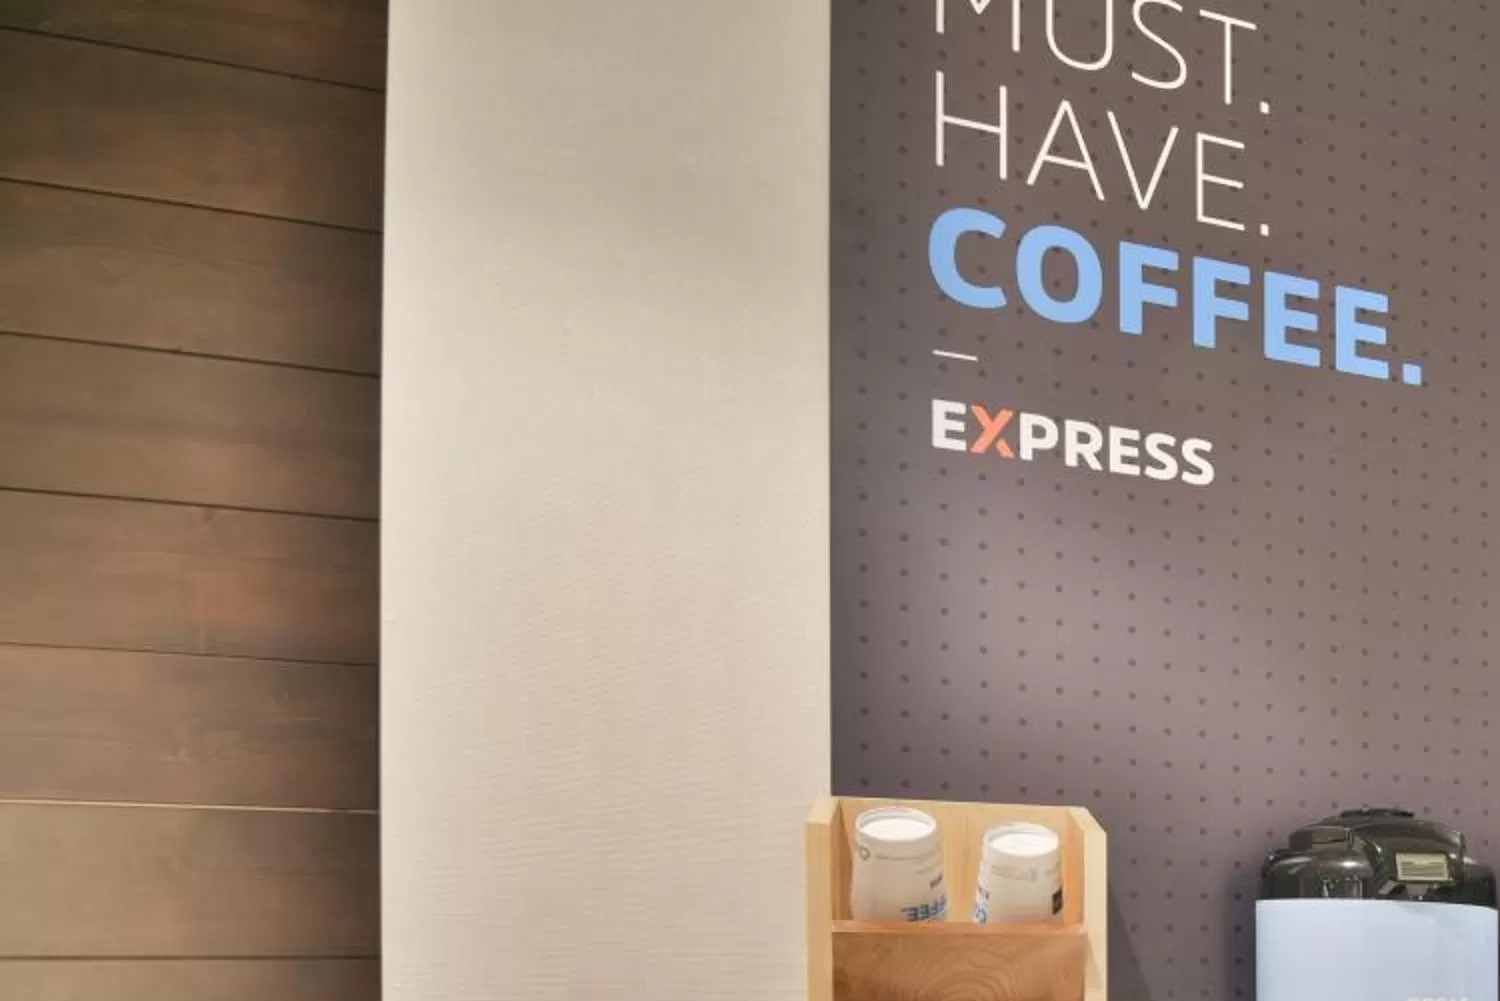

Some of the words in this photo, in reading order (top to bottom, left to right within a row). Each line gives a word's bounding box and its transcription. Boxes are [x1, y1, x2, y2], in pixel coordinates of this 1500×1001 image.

[935, 70, 1270, 237] HAVE.
[927, 206, 1423, 386] COFFEE.
[931, 398, 1215, 487] EXPRESS
